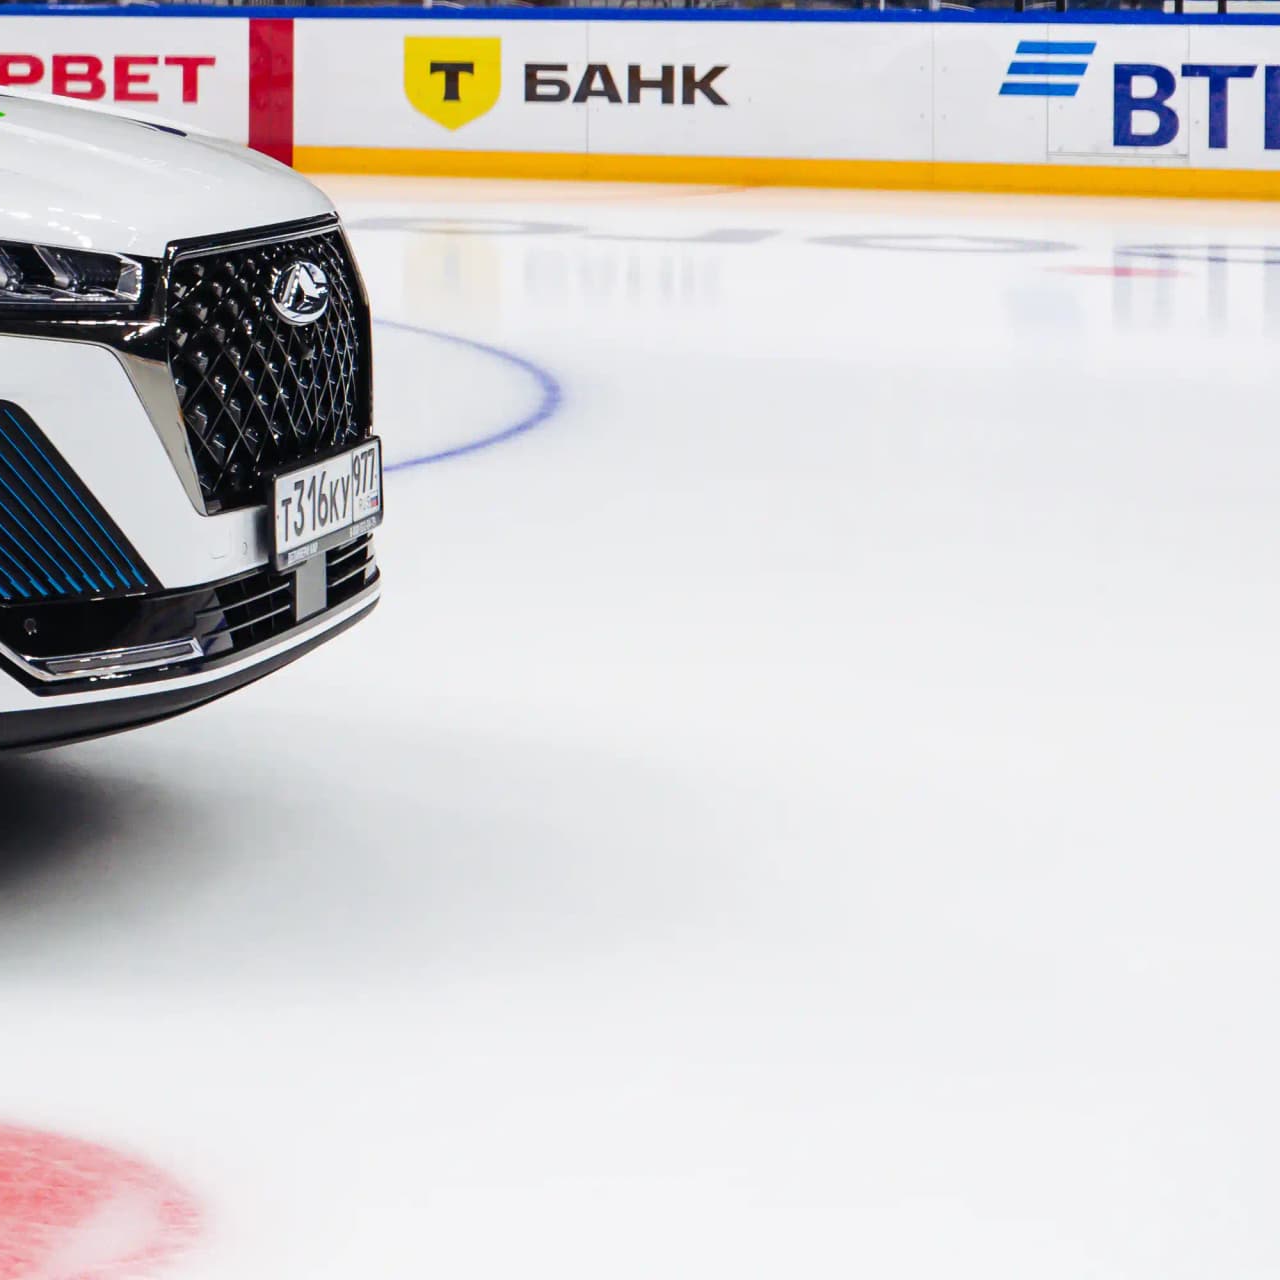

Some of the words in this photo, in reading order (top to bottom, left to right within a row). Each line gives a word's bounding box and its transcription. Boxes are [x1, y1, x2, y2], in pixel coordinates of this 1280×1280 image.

[429, 61, 475, 102] Т
[524, 63, 729, 106] БАНК
[1112, 62, 1280, 150] ВТ
[352, 447, 375, 497] 977
